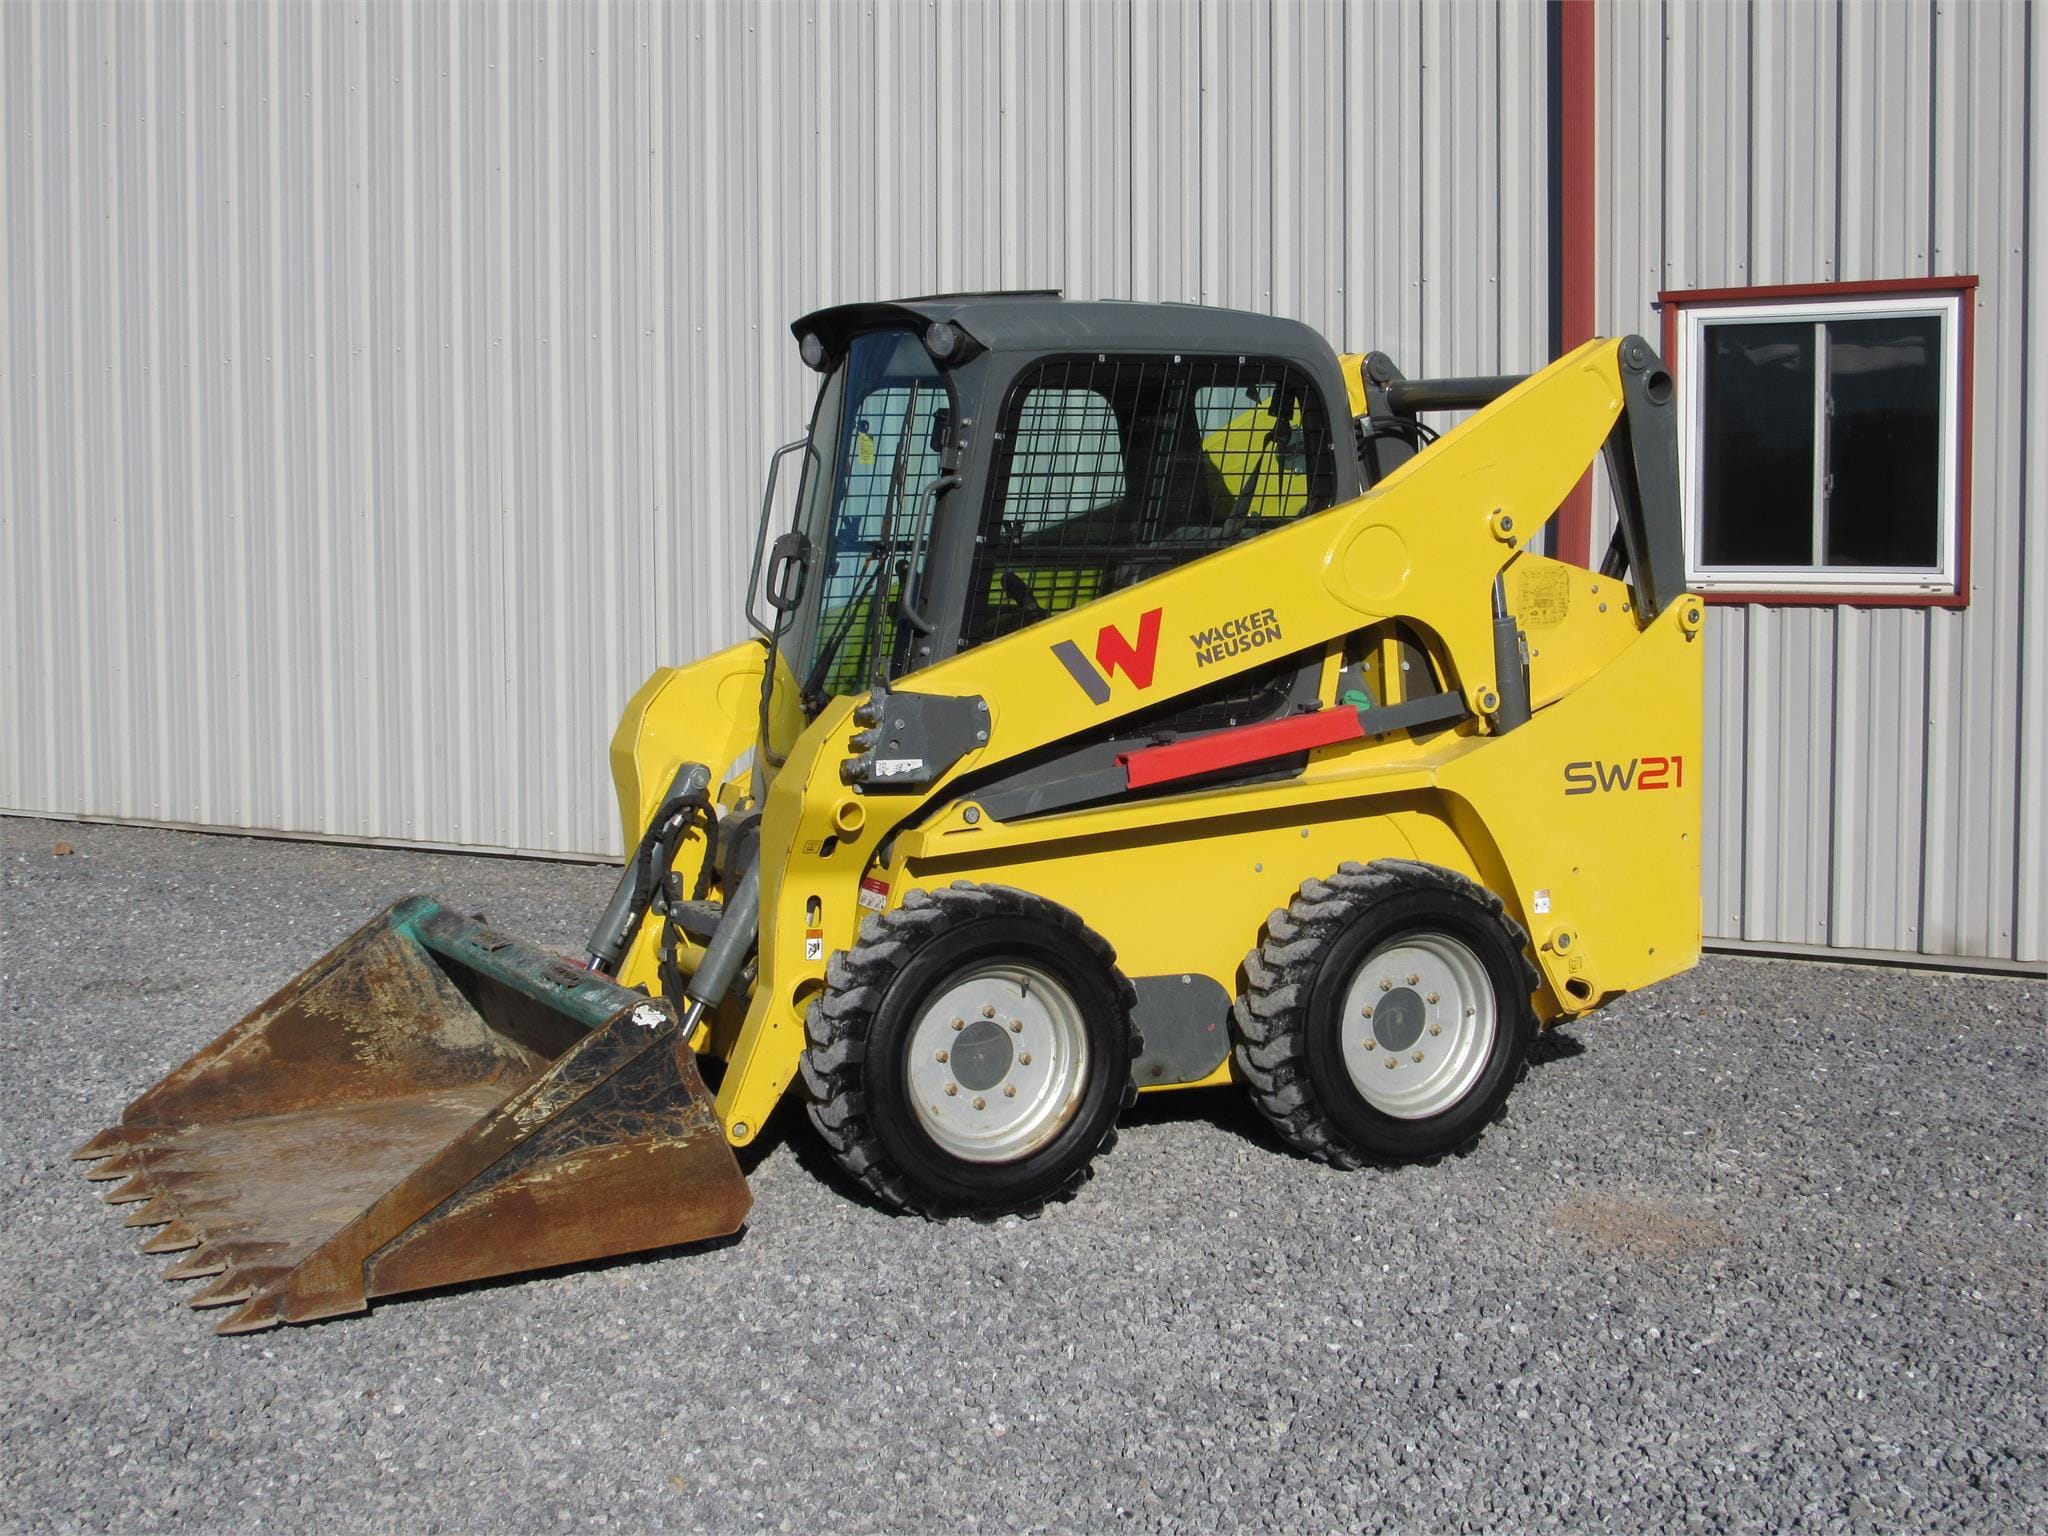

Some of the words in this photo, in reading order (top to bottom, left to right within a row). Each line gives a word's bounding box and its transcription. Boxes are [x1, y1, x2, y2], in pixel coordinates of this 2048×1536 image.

[1189, 607, 1278, 650] WACKER
[1195, 623, 1283, 668] NEUSON
[1564, 756, 1683, 795] SW21
